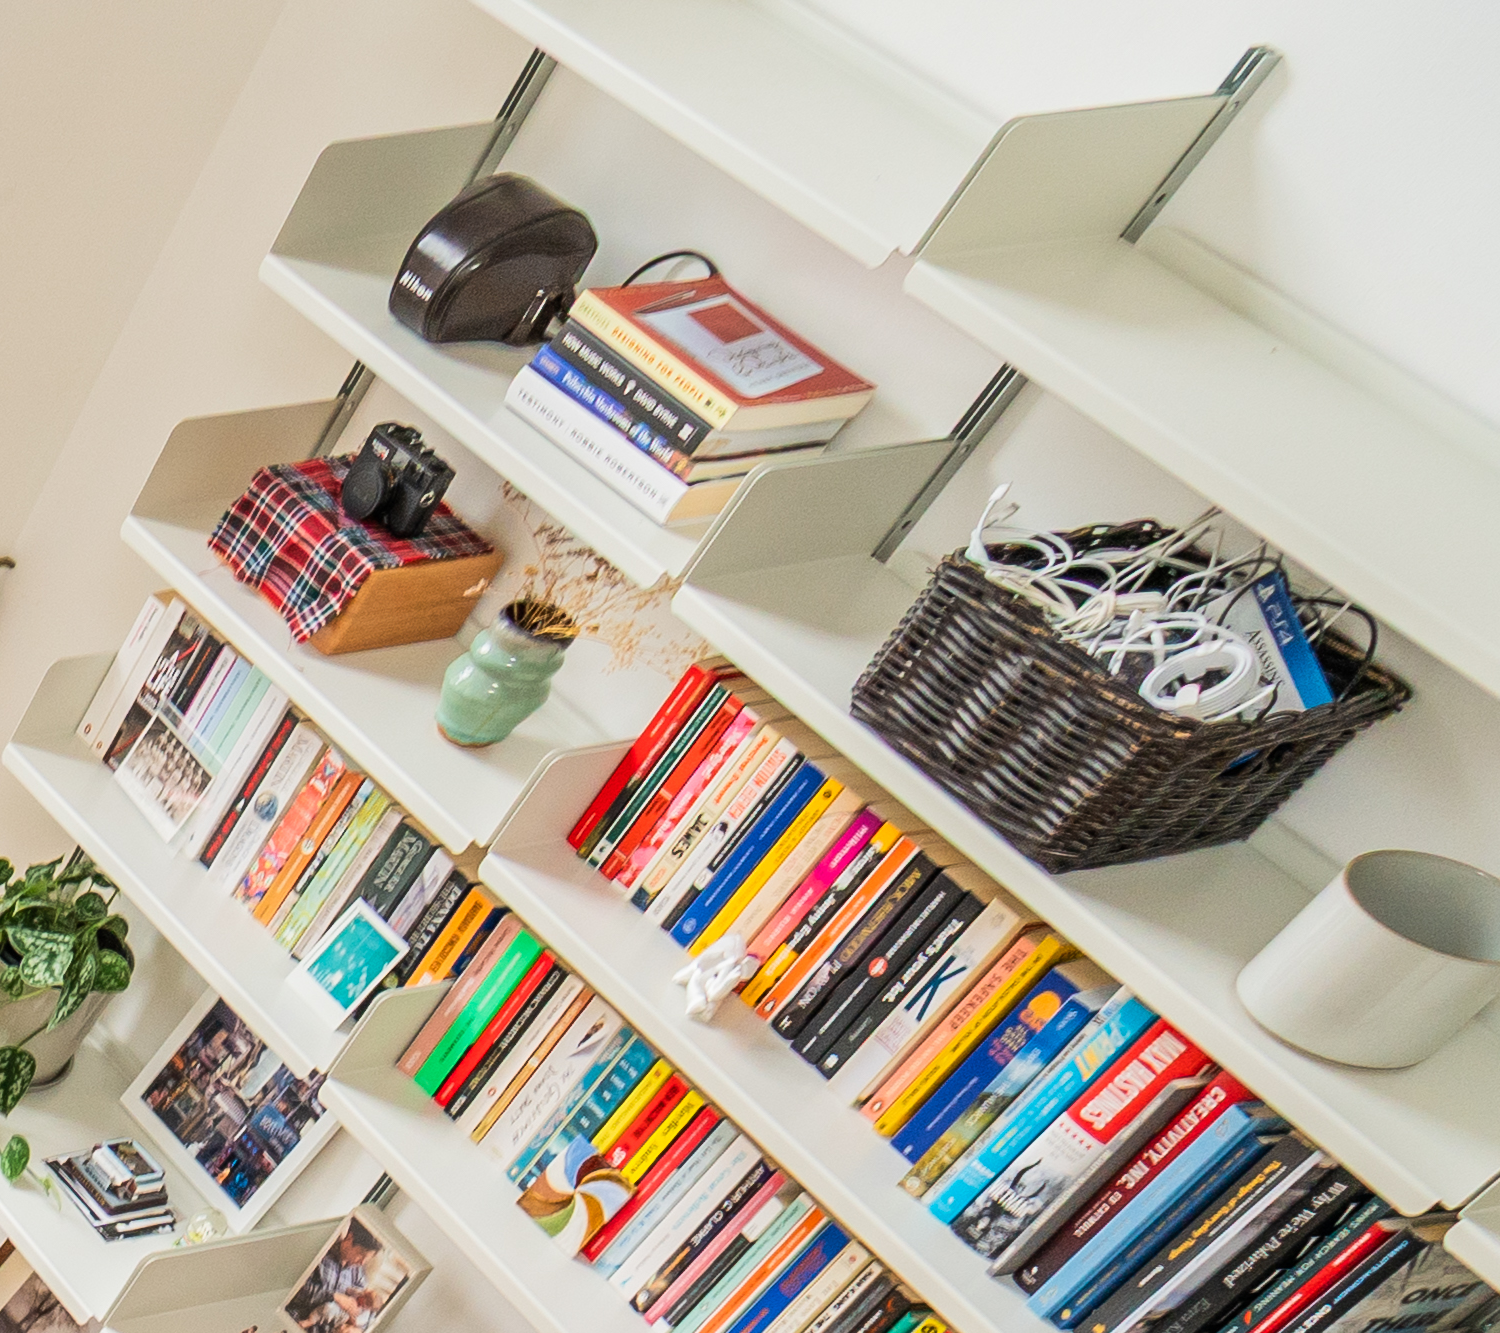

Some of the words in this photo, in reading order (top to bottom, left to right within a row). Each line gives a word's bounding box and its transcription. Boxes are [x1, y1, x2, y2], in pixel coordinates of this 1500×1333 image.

[399, 268, 434, 302] Nikon
[560, 331, 583, 354] HOW
[576, 344, 604, 370] MUSIC
[597, 360, 627, 388] WORKS
[610, 326, 656, 366] DESIGNING
[654, 360, 674, 379] FOR
[671, 374, 705, 403] PEOPLE
[560, 371, 598, 405] Psilocybin
[592, 396, 634, 433] Mushrooms
[635, 429, 653, 447] the
[646, 438, 674, 463] World
[631, 388, 657, 412] DAVID
[651, 403, 679, 429] BYRNE
[514, 388, 565, 430] TESTIMONY
[568, 428, 604, 459] ROBBIE
[602, 454, 658, 500] ROBERTSON
[751, 747, 786, 788] STATION
[725, 784, 757, 820] ELEVEN
[668, 811, 711, 861] JAMES
[826, 822, 869, 870] Milkman
[371, 831, 417, 889] MARTIN
[887, 866, 923, 904] MICK
[836, 900, 894, 964] FLEETWOOD
[922, 914, 964, 958] That's
[898, 951, 931, 985] your
[1001, 946, 1028, 973] THE
[878, 979, 907, 1007] lot.
[945, 972, 1004, 1033] SAFEKEEP
[1137, 1028, 1187, 1075] MAX
[1077, 1058, 1156, 1133] HASTINGS
[1143, 1084, 1228, 1166] CREATIVITY,
[727, 1161, 768, 1205] ARTHUR
[1115, 1159, 1151, 1194] INC.
[1234, 1171, 1265, 1200] Design
[1261, 1157, 1281, 1175] The
[670, 1191, 710, 1233] Believers
[1106, 1189, 1122, 1204] ED
[1310, 1177, 1348, 1211] Why
[687, 1208, 725, 1248] CLARKE
[1189, 1203, 1230, 1240] Everyday
[1273, 1204, 1317, 1243] We're
[1164, 1234, 1196, 1263] Things
[1312, 1225, 1351, 1260] SEARCH
[1220, 1235, 1282, 1290] Polarized
[1293, 1256, 1315, 1277] FOR
[831, 1285, 857, 1311] KANG
[1179, 1296, 1211, 1325] Ezra
[1251, 1274, 1296, 1314] MEANING
[814, 1311, 832, 1329] THE
[1299, 1300, 1333, 1331] ONCE
